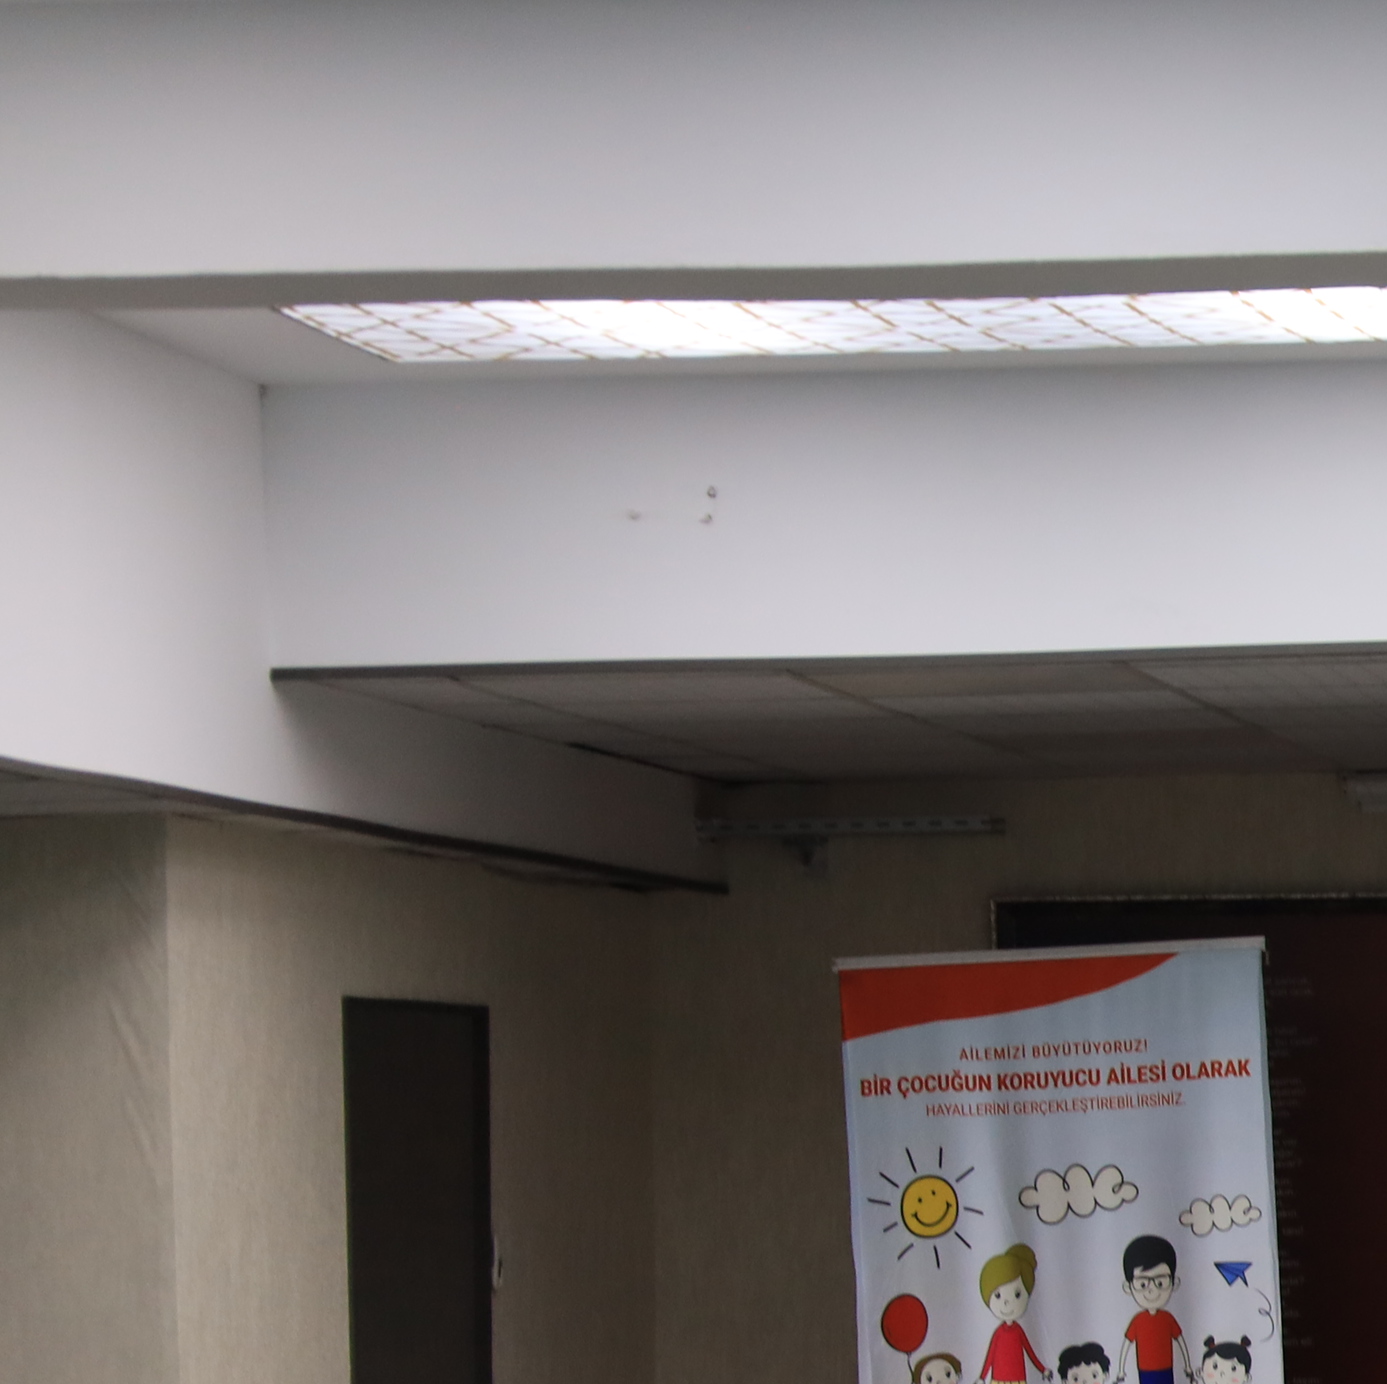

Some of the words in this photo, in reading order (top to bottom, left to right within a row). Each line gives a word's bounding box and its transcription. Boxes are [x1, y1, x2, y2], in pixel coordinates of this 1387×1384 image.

[959, 1044, 1026, 1061] AİLEMİZİ
[1032, 1039, 1148, 1058] BÜYÜTÜYORUZ!
[860, 1073, 891, 1097] BİR
[897, 1069, 992, 1099] ÇOCUĞUN
[997, 1068, 1100, 1091] KORUYUCU
[1106, 1059, 1166, 1085] AİLESİ
[1172, 1059, 1251, 1081] OLARAK
[926, 1101, 1009, 1117] HAYALLERİNİ
